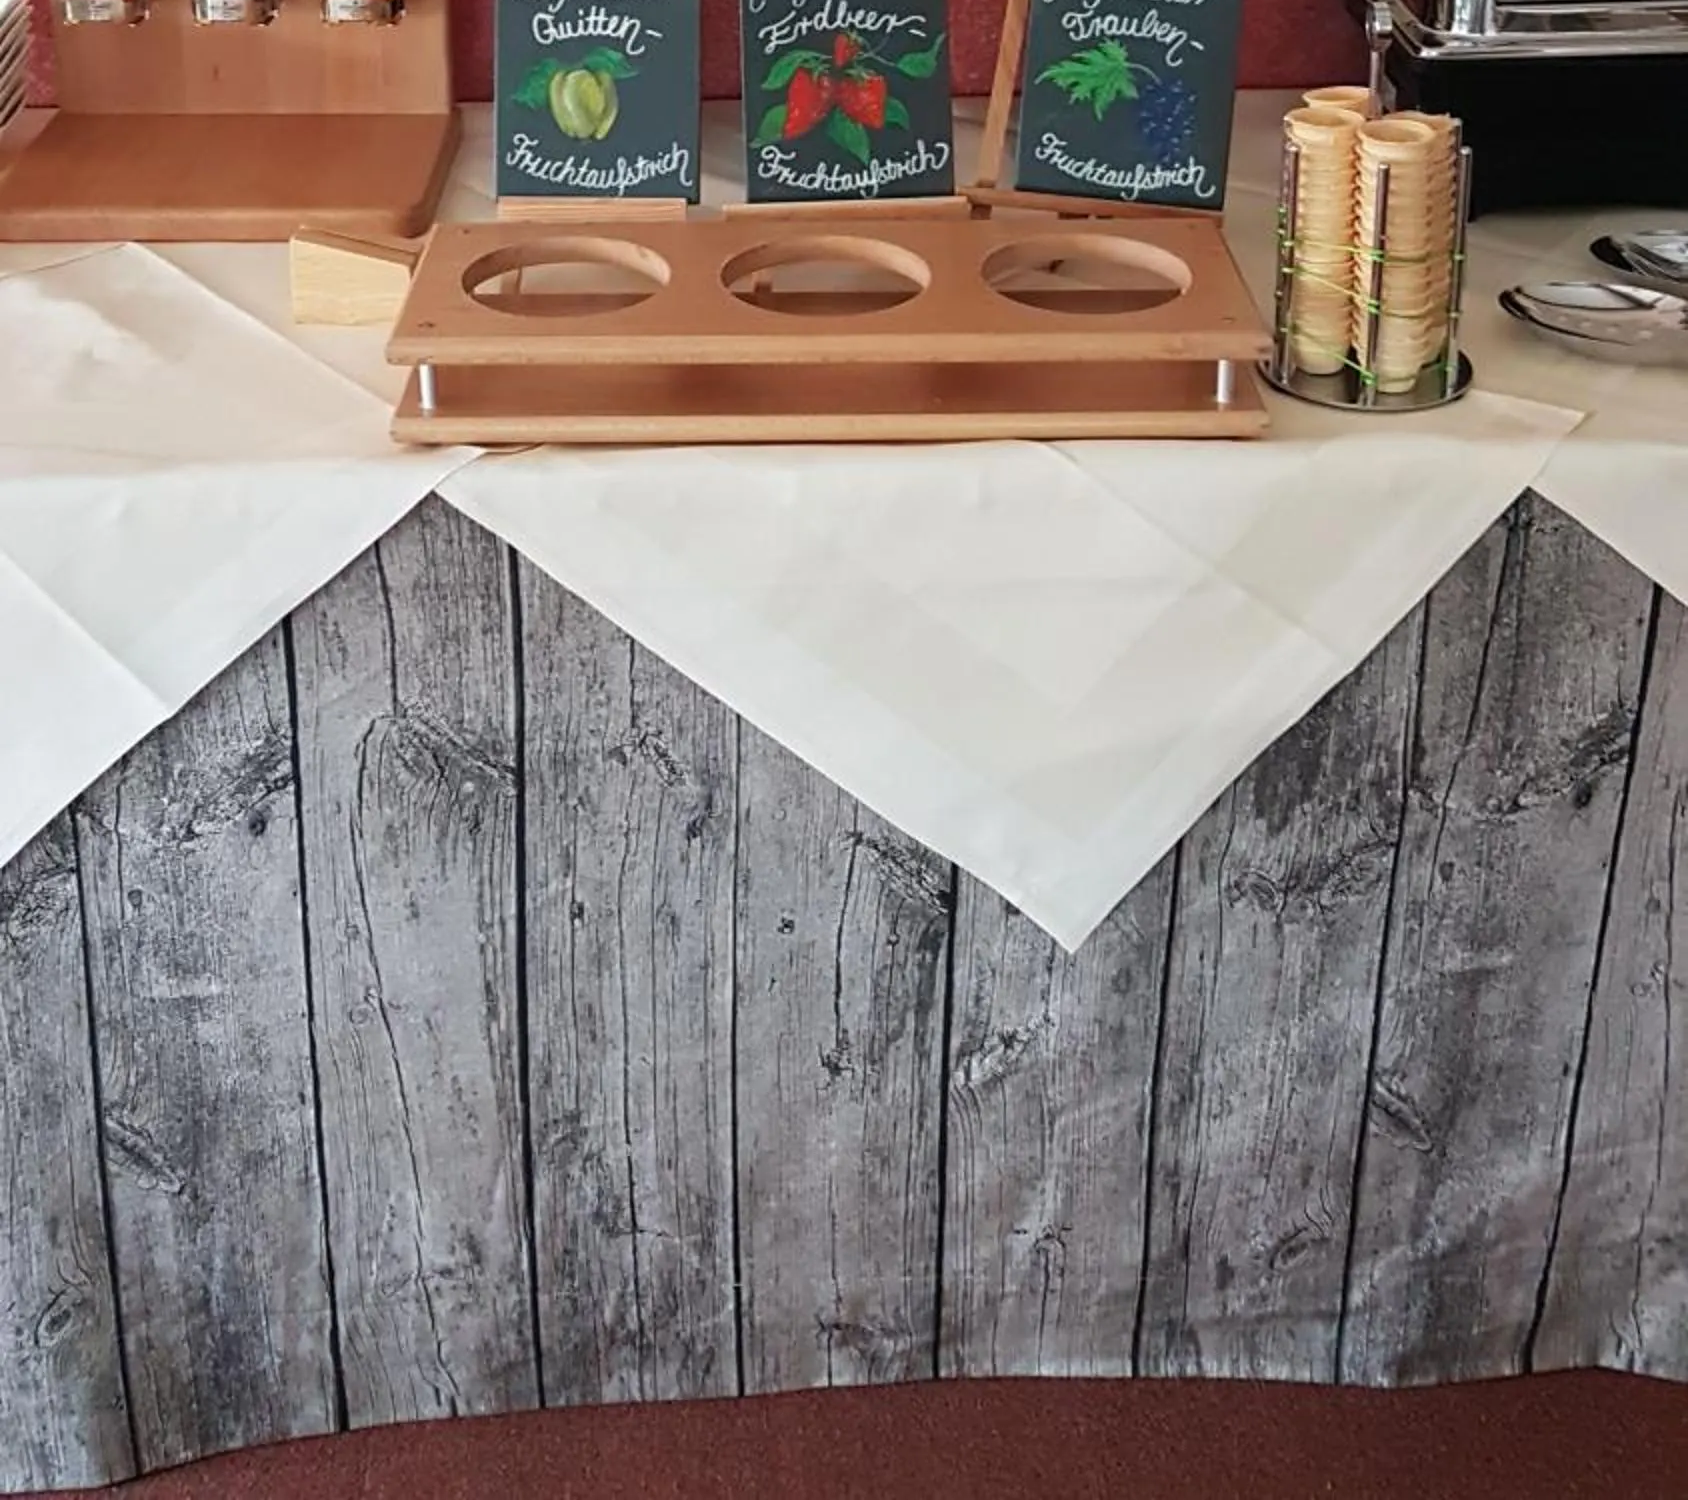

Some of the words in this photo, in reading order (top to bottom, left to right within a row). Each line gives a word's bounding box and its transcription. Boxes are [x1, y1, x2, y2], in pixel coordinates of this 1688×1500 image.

[506, 133, 693, 196] Fruchtaufstrich
[758, 139, 949, 197] Fruchtaufstrich
[1035, 132, 1216, 200] Fruchtaufstrich
